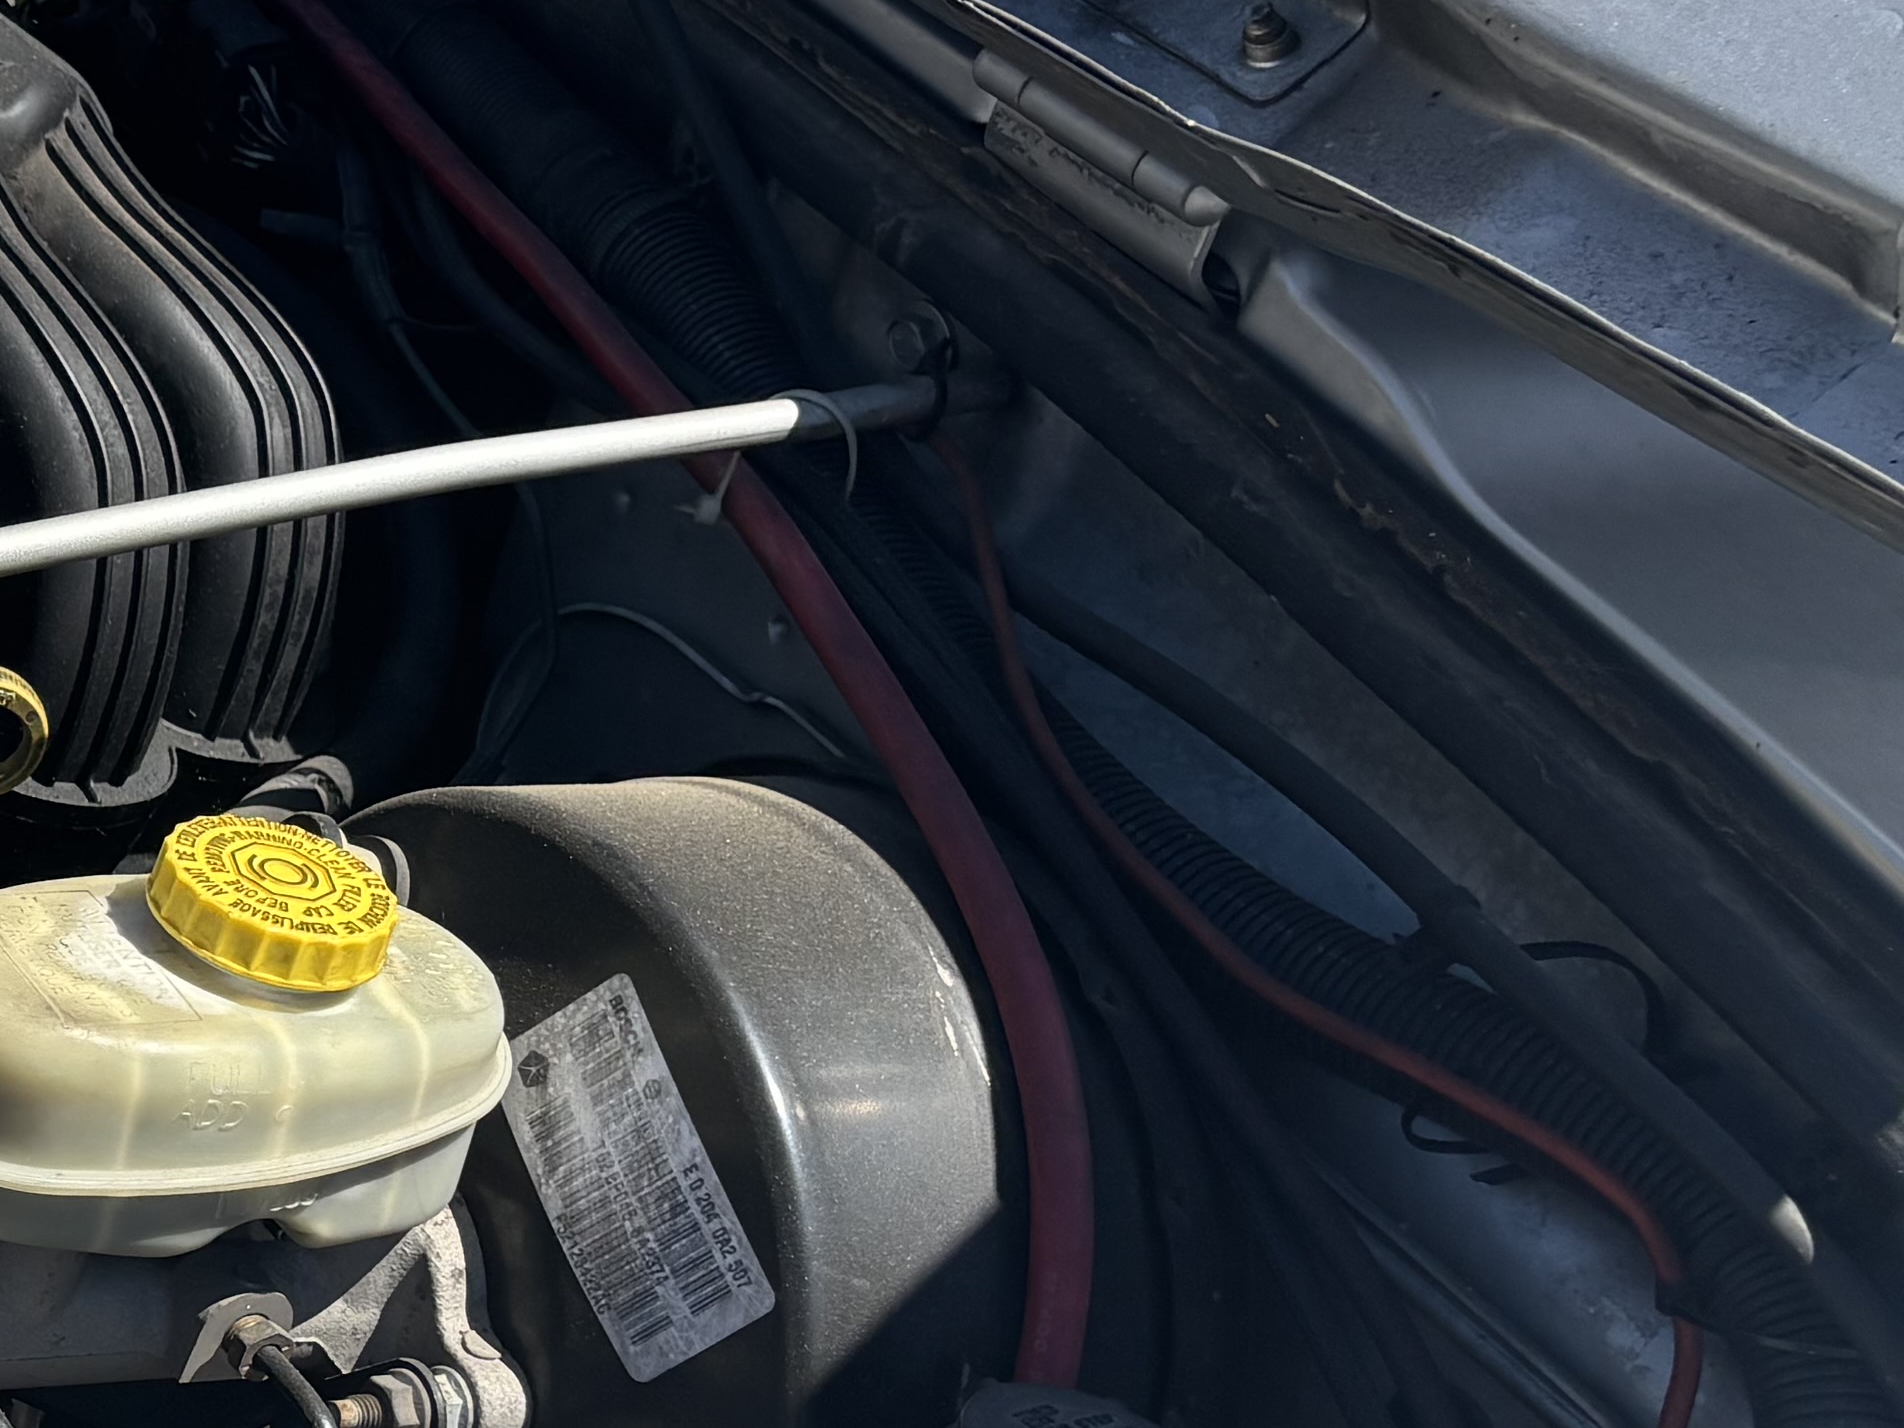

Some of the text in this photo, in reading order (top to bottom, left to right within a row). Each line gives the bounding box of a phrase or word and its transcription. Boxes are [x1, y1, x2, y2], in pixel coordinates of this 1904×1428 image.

[183, 866, 229, 897] AVANT
[223, 879, 290, 912] BEFORE
[302, 905, 335, 918] CAP
[608, 994, 644, 1059] BOSCH
[681, 1163, 699, 1180] E
[693, 1191, 722, 1226] 204
[726, 1258, 754, 1292] 507
